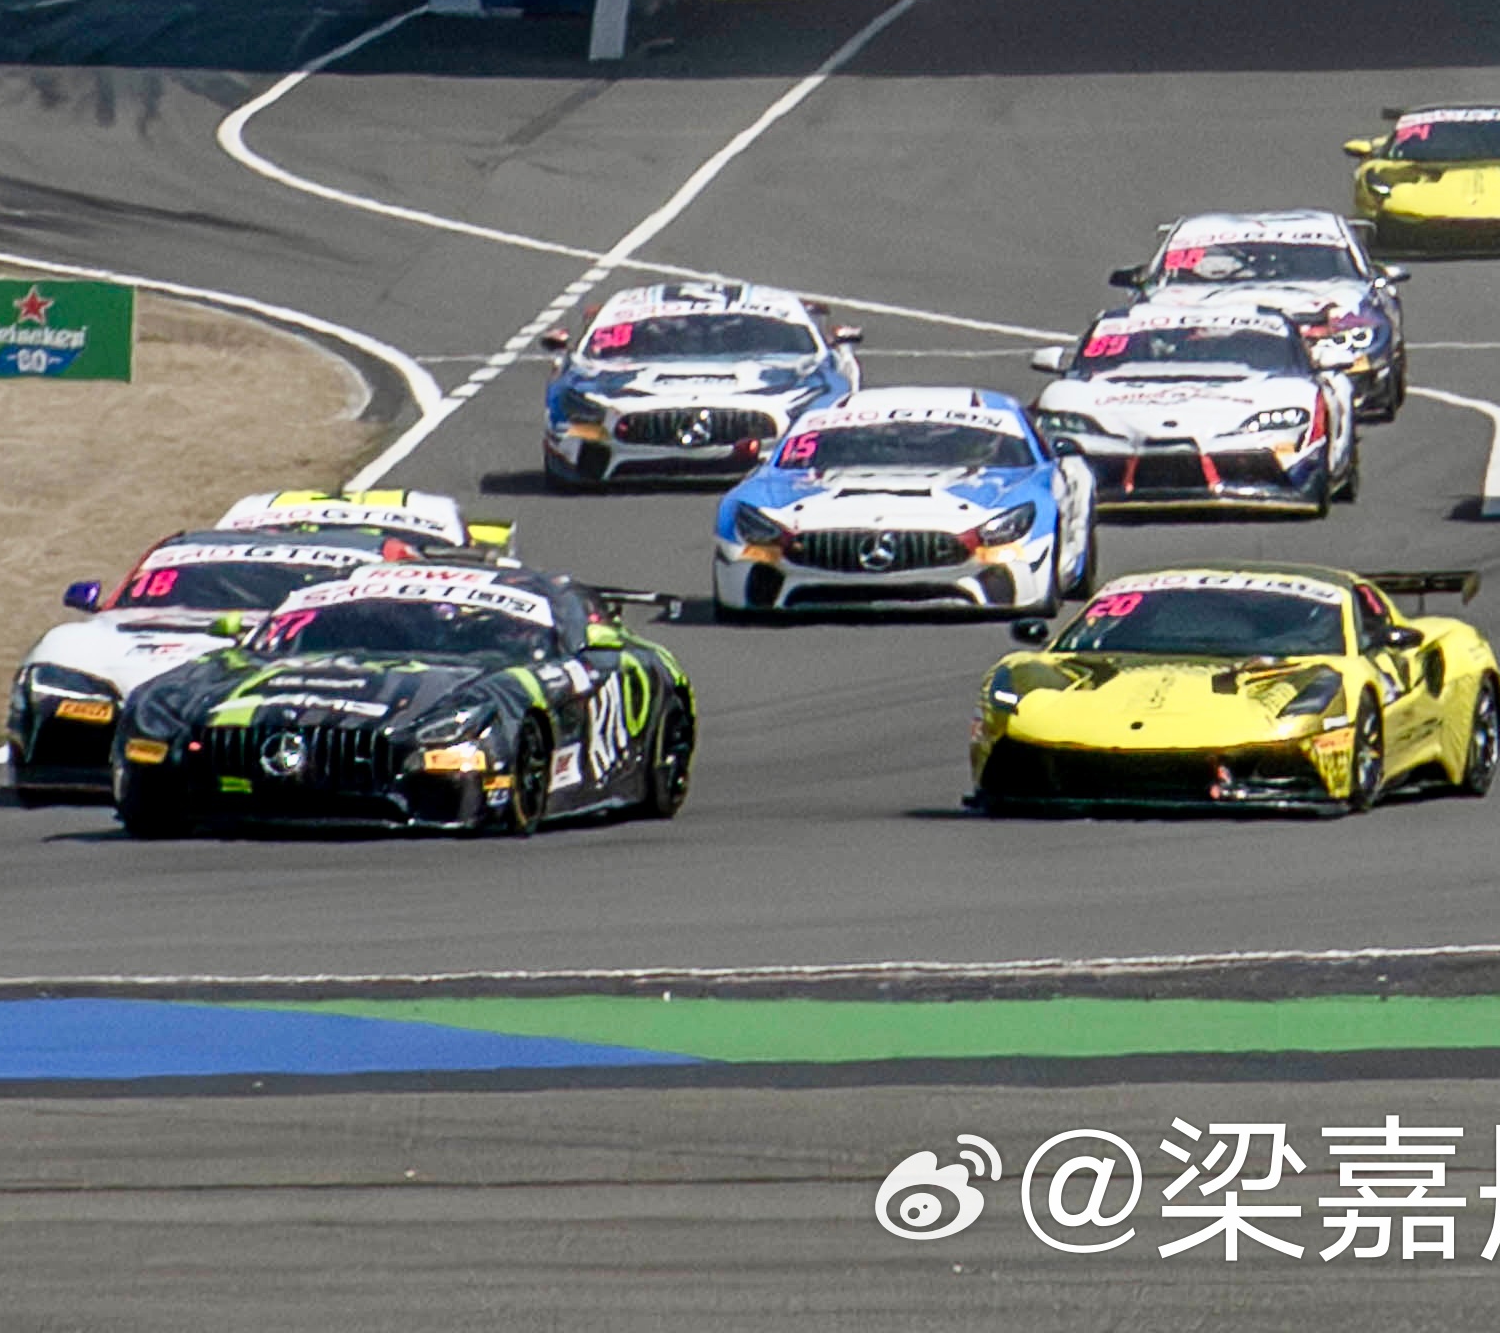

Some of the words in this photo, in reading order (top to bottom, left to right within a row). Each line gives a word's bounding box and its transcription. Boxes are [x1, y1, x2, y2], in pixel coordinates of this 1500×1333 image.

[780, 432, 821, 462] 15
[130, 568, 180, 598] 18
[367, 566, 489, 583] ROWE
[398, 583, 462, 599] GT
[1085, 592, 1144, 619] 20
